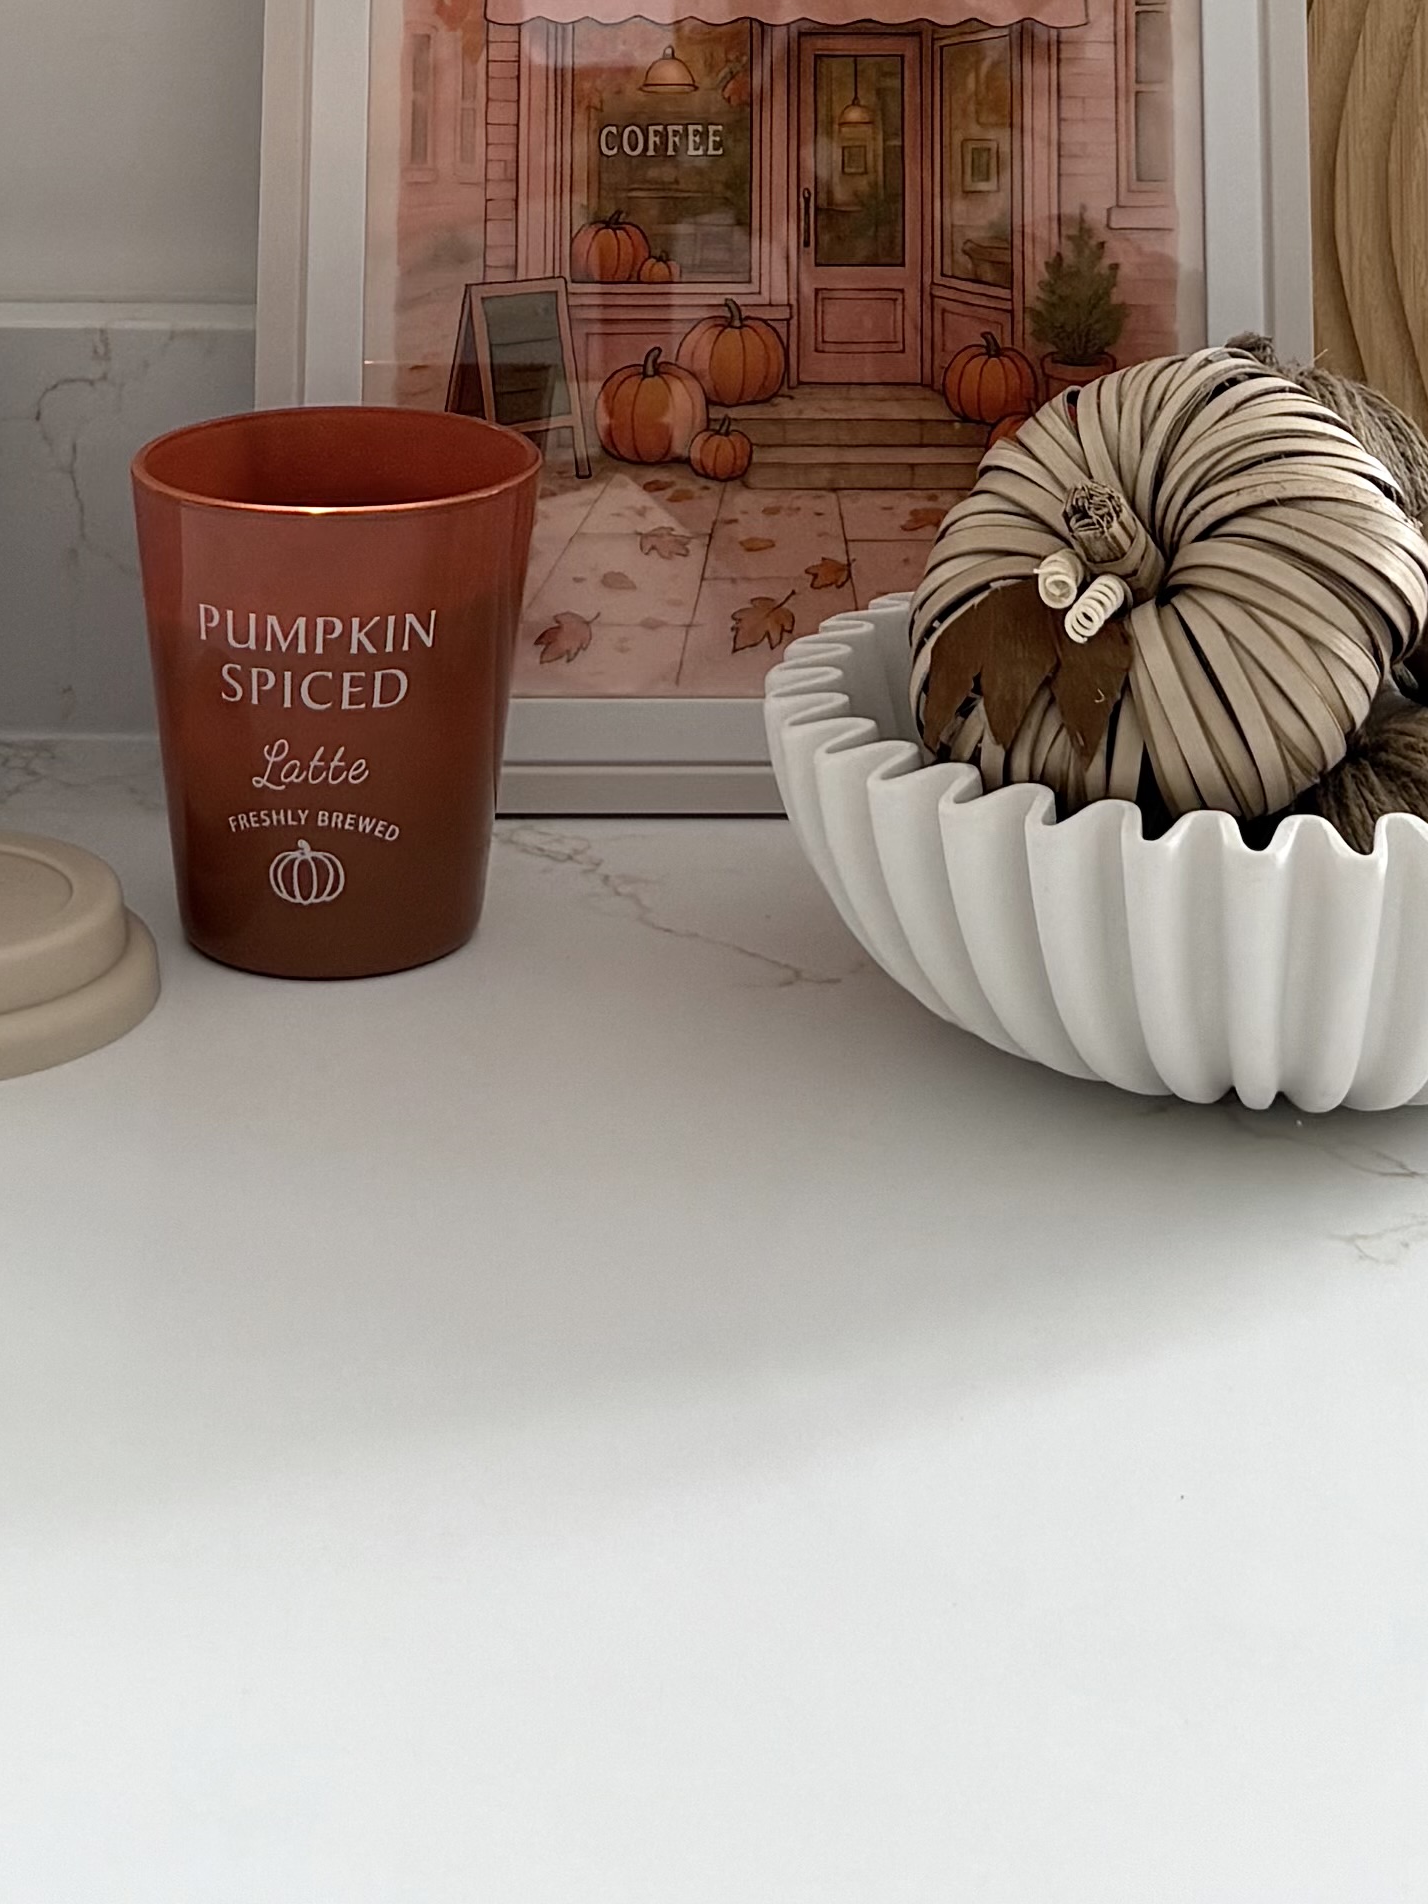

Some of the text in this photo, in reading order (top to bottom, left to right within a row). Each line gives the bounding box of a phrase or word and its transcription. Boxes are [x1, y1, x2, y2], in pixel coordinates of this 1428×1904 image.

[598, 123, 725, 158] COFFEE
[197, 602, 437, 655] PUMPKIN
[220, 662, 409, 711] SPICED
[252, 738, 370, 791] Latte
[227, 808, 400, 842] FRESHLY BREWED
